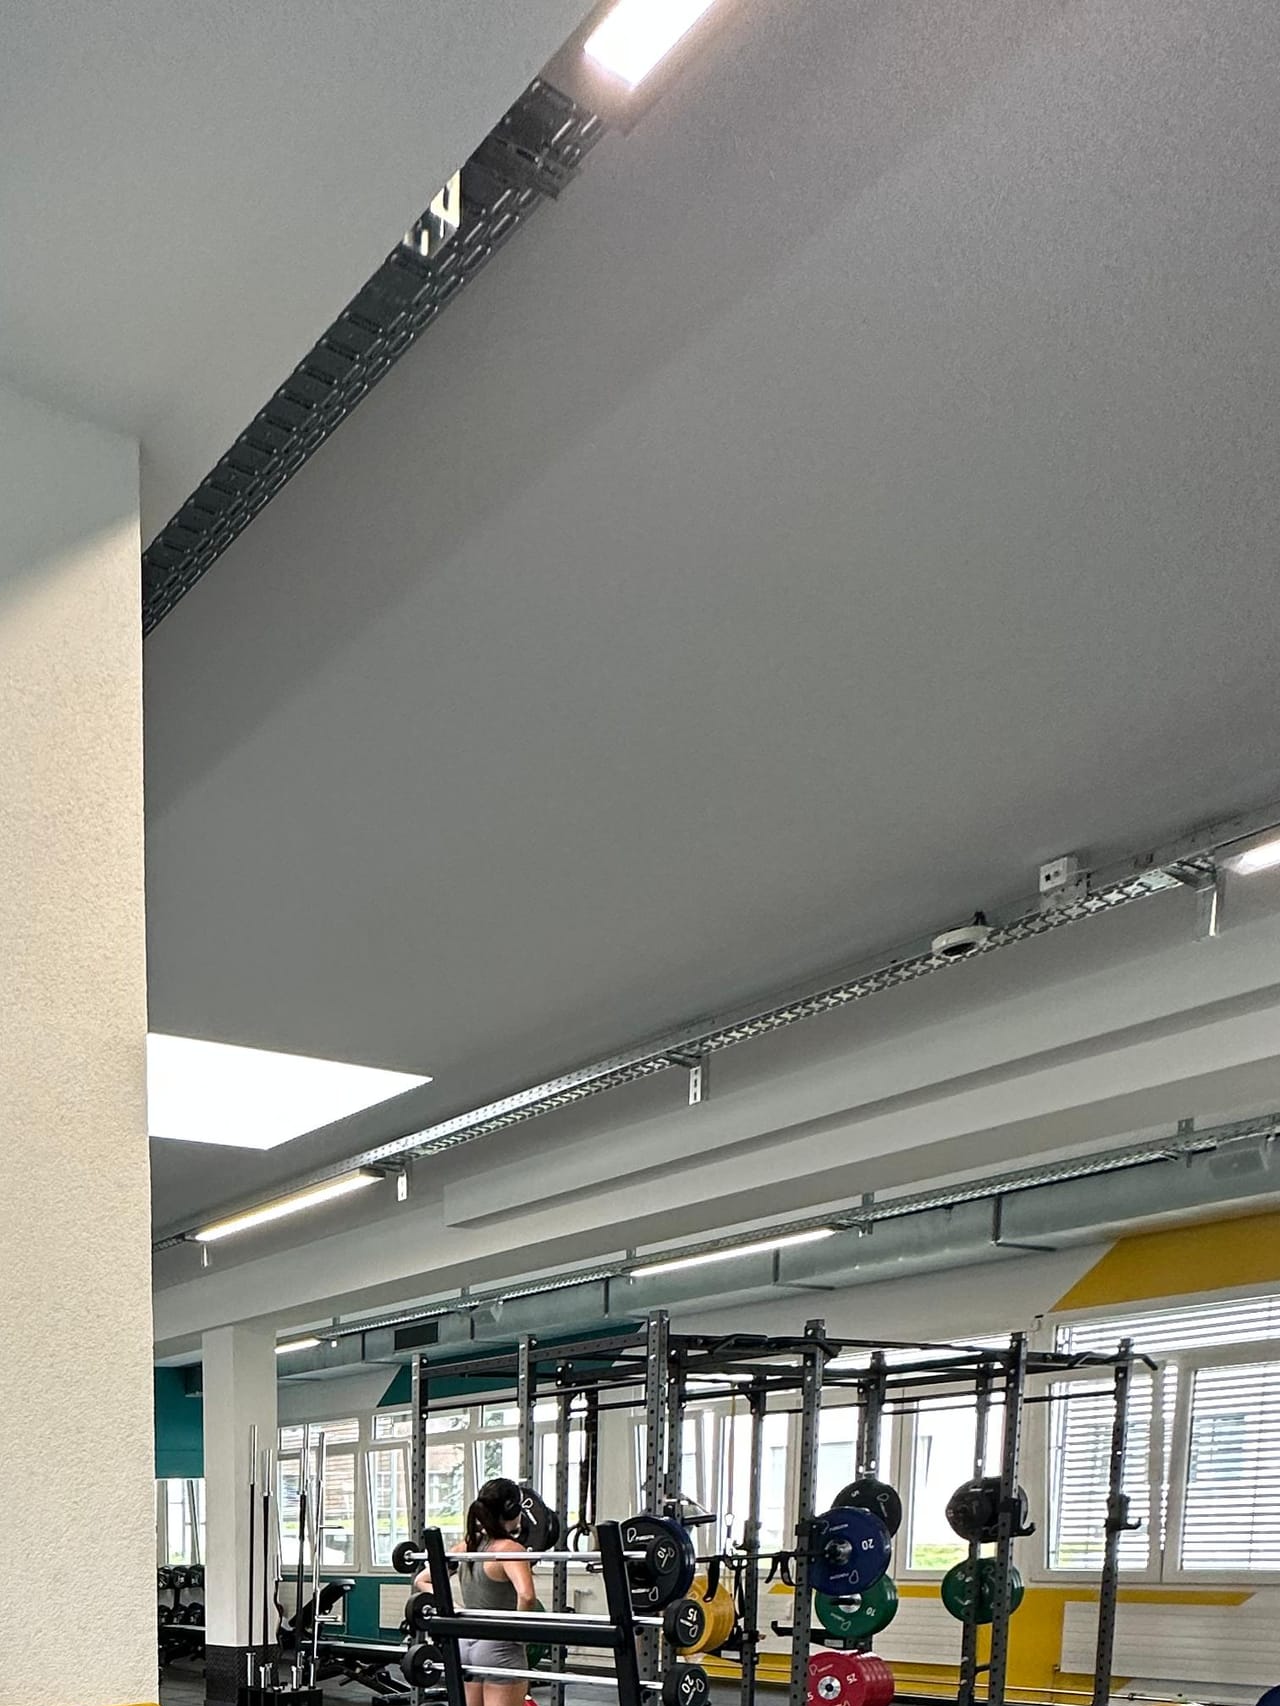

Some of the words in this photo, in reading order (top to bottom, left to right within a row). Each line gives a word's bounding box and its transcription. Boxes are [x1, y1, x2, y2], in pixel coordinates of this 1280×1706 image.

[861, 1538, 874, 1551] 20
[687, 1608, 698, 1622] 15
[866, 1607, 876, 1617] 10
[681, 1674, 695, 1694] 20
[846, 1673, 858, 1685] 25
